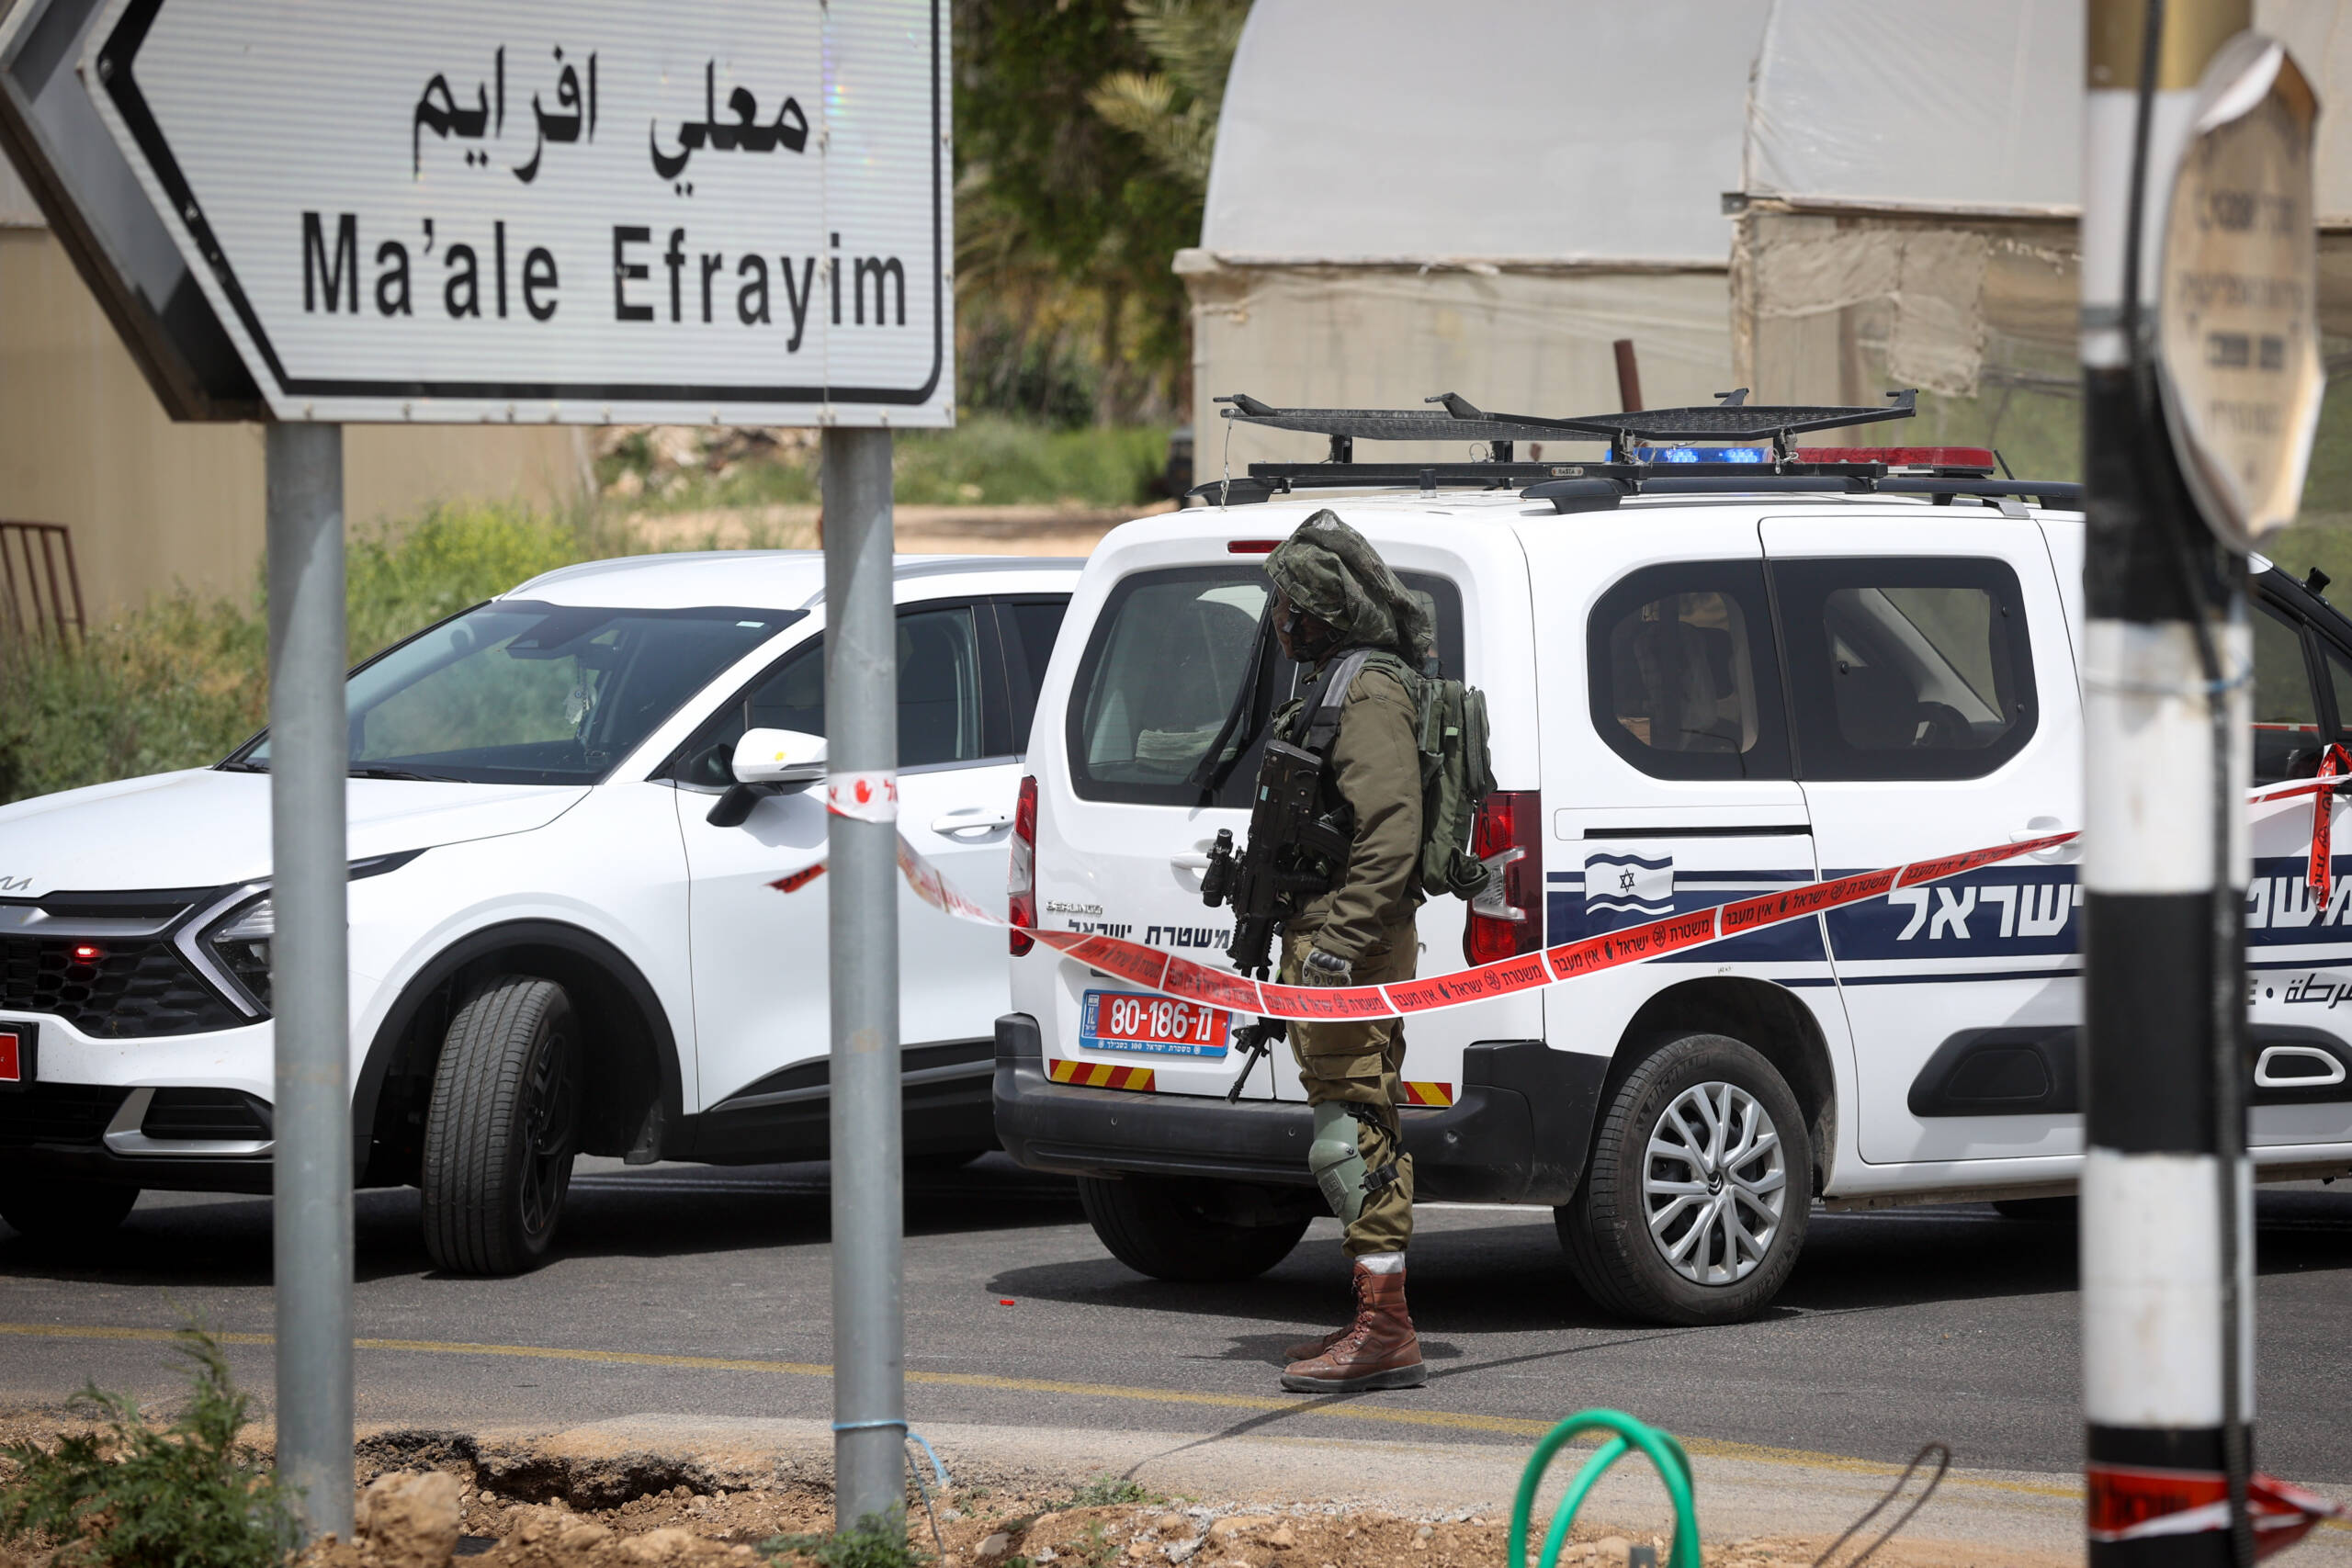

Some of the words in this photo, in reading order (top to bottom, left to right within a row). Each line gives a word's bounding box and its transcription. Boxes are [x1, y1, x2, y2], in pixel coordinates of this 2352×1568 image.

[413, 44, 598, 185] افرايم
[649, 57, 809, 197] معلي
[300, 210, 560, 322] Ma'ale
[612, 225, 907, 354] Efrayim
[1846, 874, 1891, 896] משטרת
[1792, 888, 1828, 909] ישראל
[1726, 908, 1756, 927] מעבר
[1757, 902, 1774, 923] אין
[1144, 925, 1231, 949] משטרת
[1669, 919, 1710, 942] משטרת
[1616, 935, 1649, 956] ישראל
[1554, 953, 1584, 973] מעבר
[1584, 948, 1600, 969] אין
[1500, 964, 1543, 986] משטרת
[1450, 978, 1483, 998] ישראל
[1393, 991, 1422, 1008] מעבר
